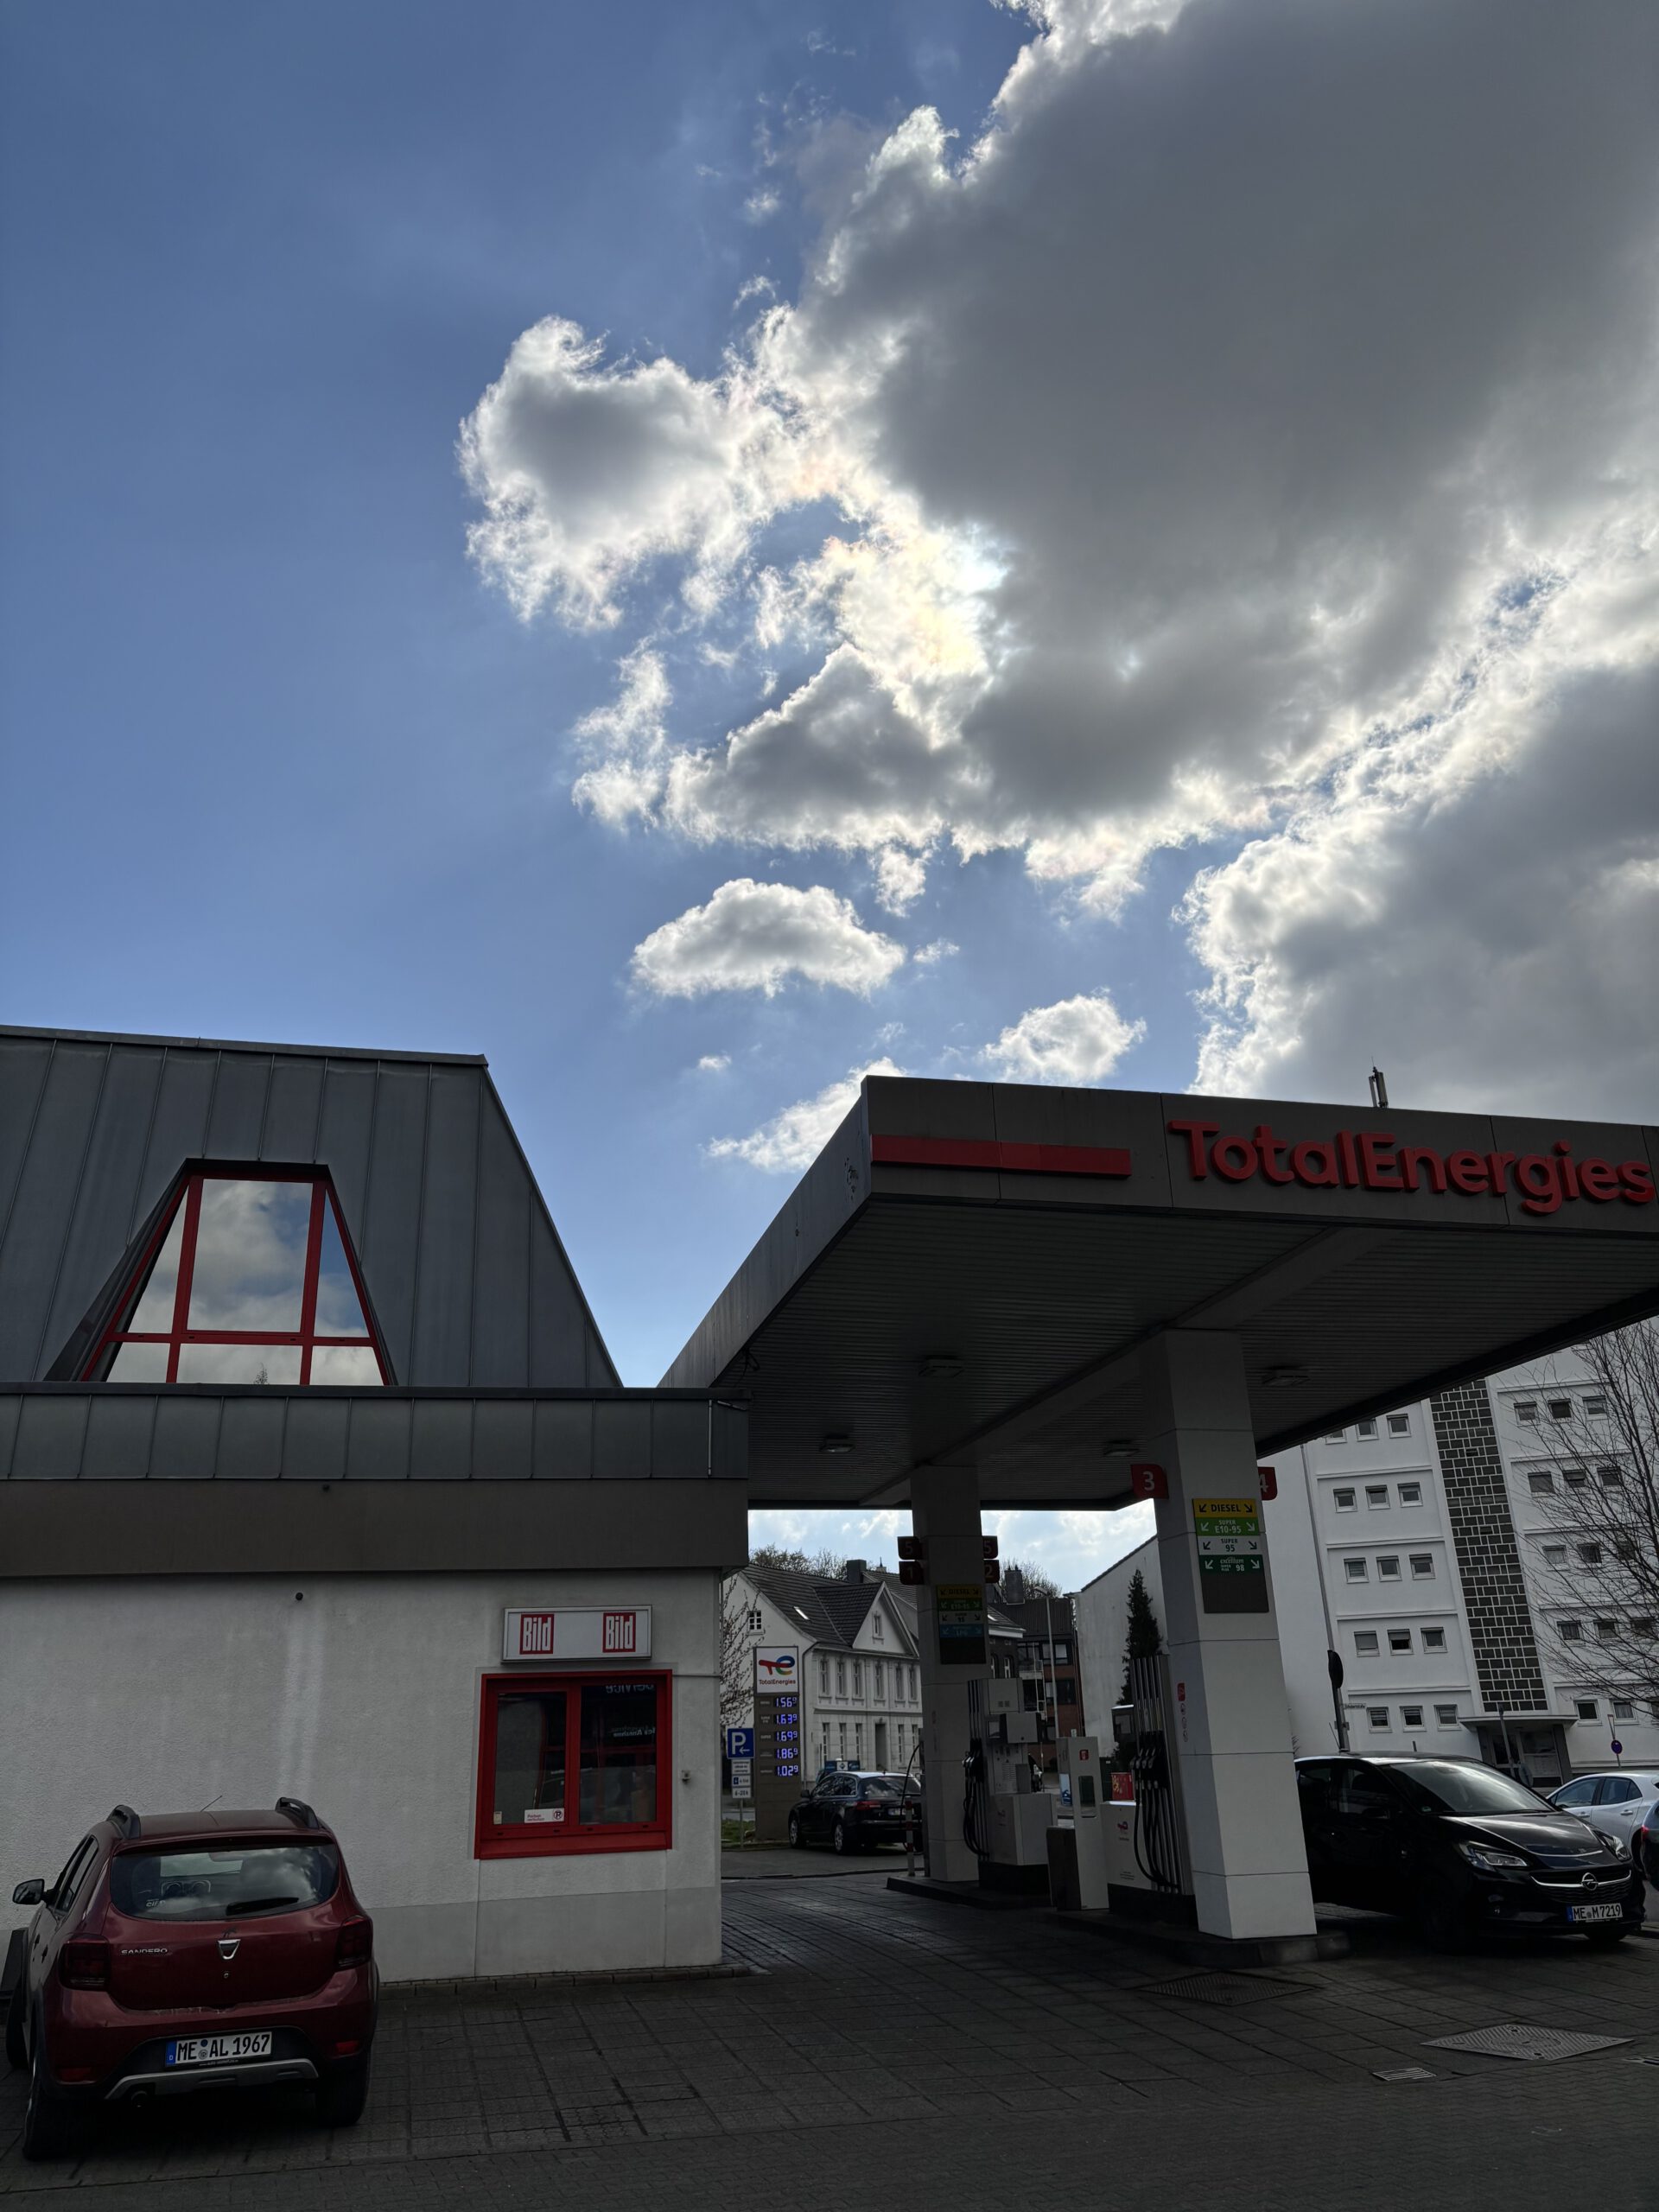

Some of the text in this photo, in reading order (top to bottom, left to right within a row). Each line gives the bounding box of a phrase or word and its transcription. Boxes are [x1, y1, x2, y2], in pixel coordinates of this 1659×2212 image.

[1169, 1120, 1655, 1215] TotalEnergies
[1142, 1470, 1155, 1491] 3
[1259, 1473, 1269, 1494] 4
[1211, 1503, 1241, 1512] DIESEL
[1215, 1525, 1242, 1534] E10-95
[906, 1541, 913, 1555] 5
[983, 1541, 992, 1554] 5
[907, 1566, 913, 1578] 1
[984, 1564, 994, 1578] 2
[522, 1617, 552, 1651] Bild
[605, 1615, 633, 1649] Bild
[732, 1732, 747, 1755] P
[1573, 1907, 1586, 1919] ME
[177, 2041, 197, 2062] ME
[209, 2038, 228, 2057] AL
[232, 2034, 270, 2056] 1967
